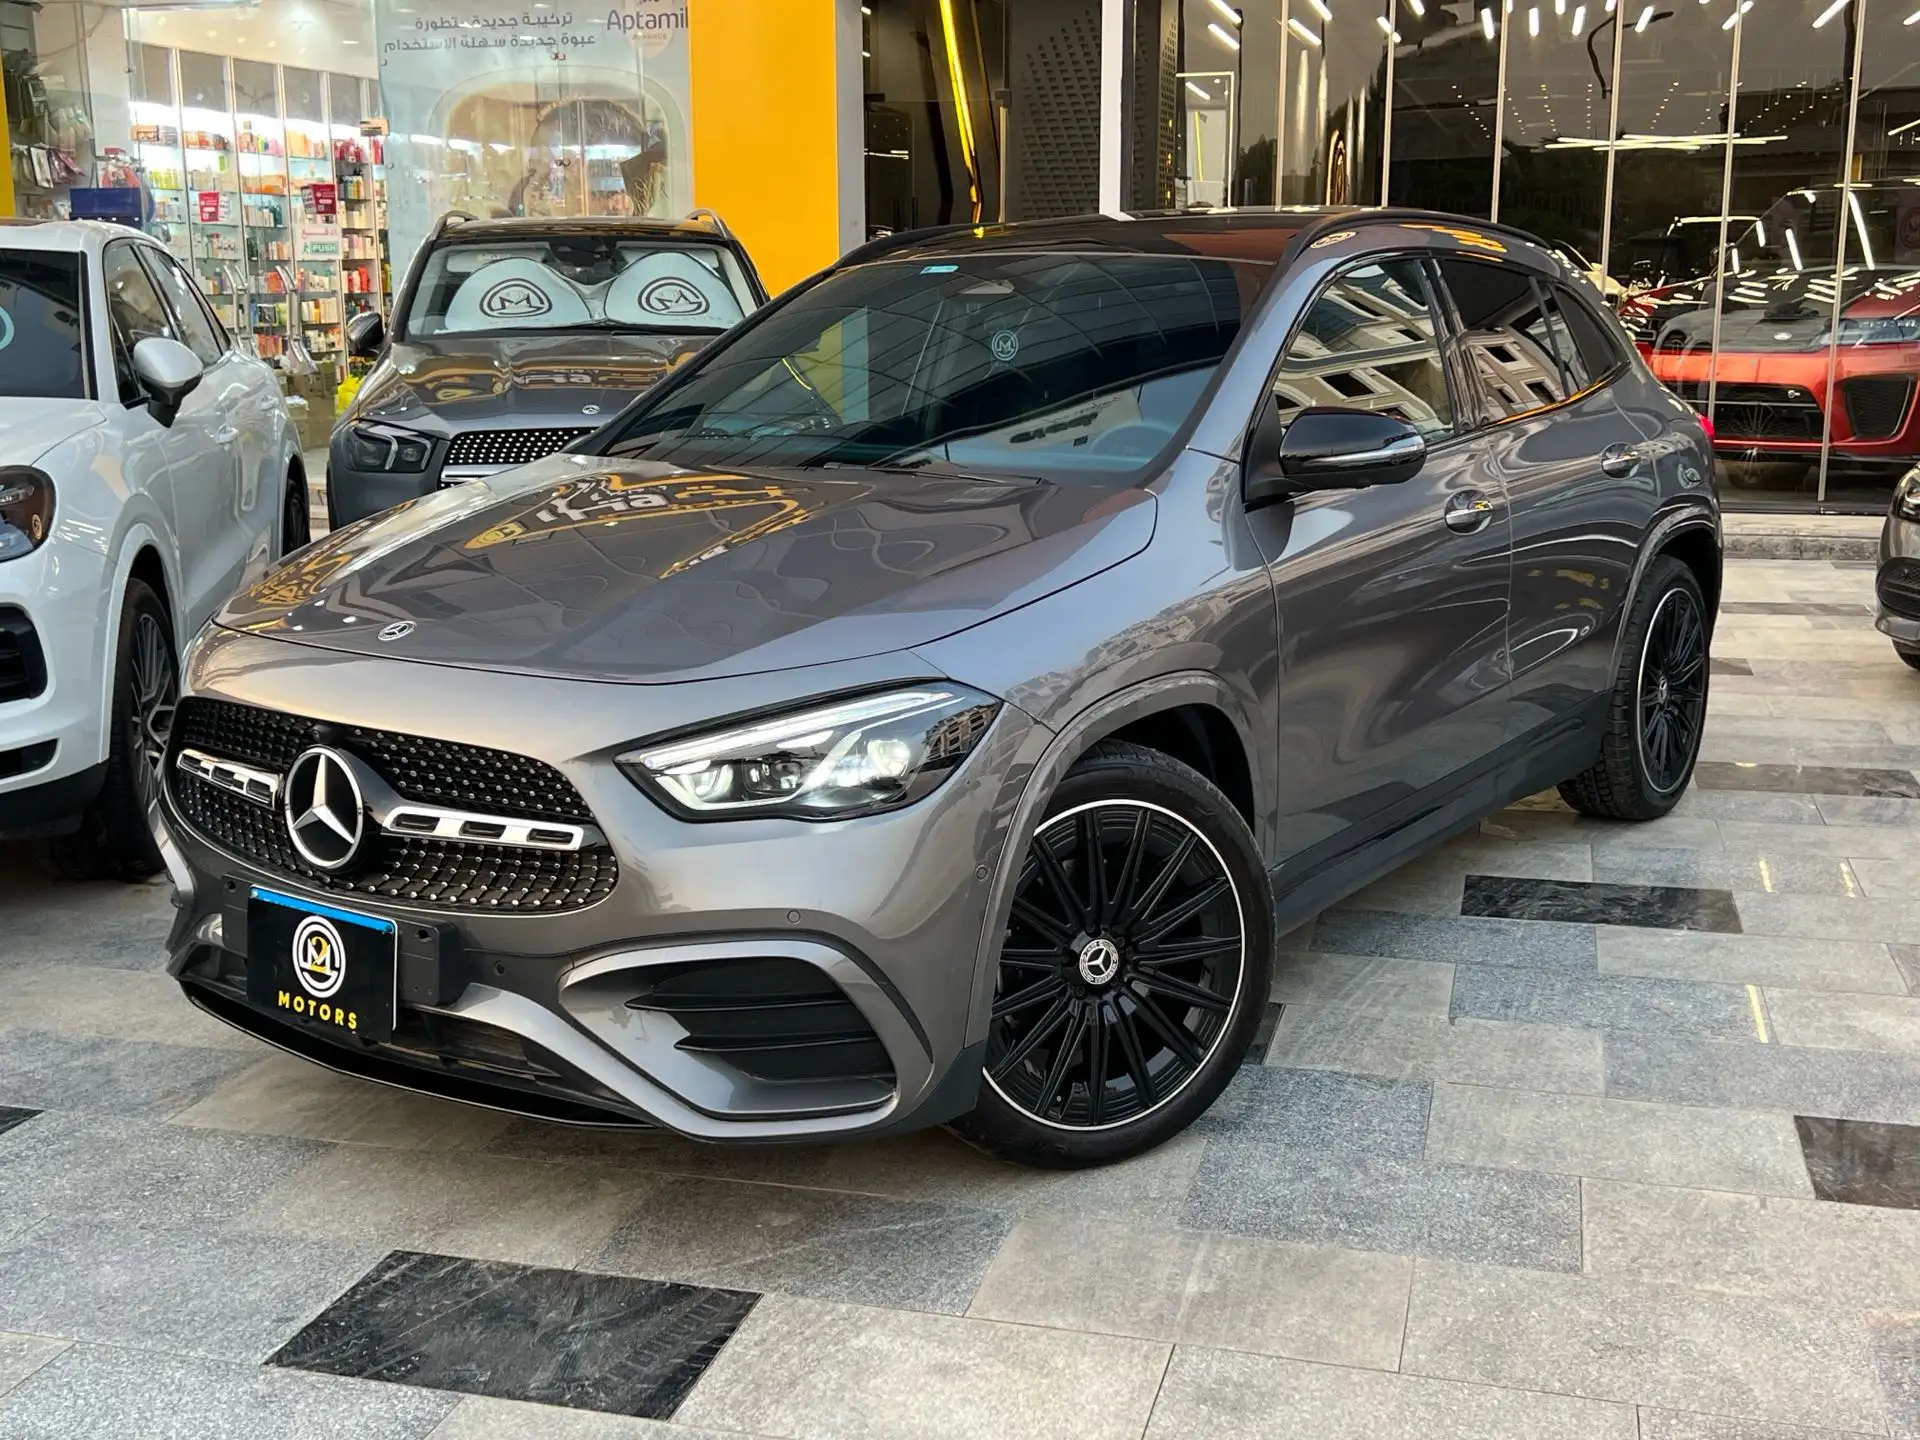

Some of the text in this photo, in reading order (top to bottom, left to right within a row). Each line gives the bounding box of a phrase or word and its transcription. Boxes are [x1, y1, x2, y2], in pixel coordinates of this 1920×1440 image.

[472, 15, 519, 30] جديدة
[522, 11, 573, 29] تركيبة
[607, 7, 689, 34] Aptamil
[384, 33, 596, 53] عبوة جديدة سهلة الاستخدام
[312, 243, 336, 253] PUSH
[278, 990, 358, 1030] MOTORS
